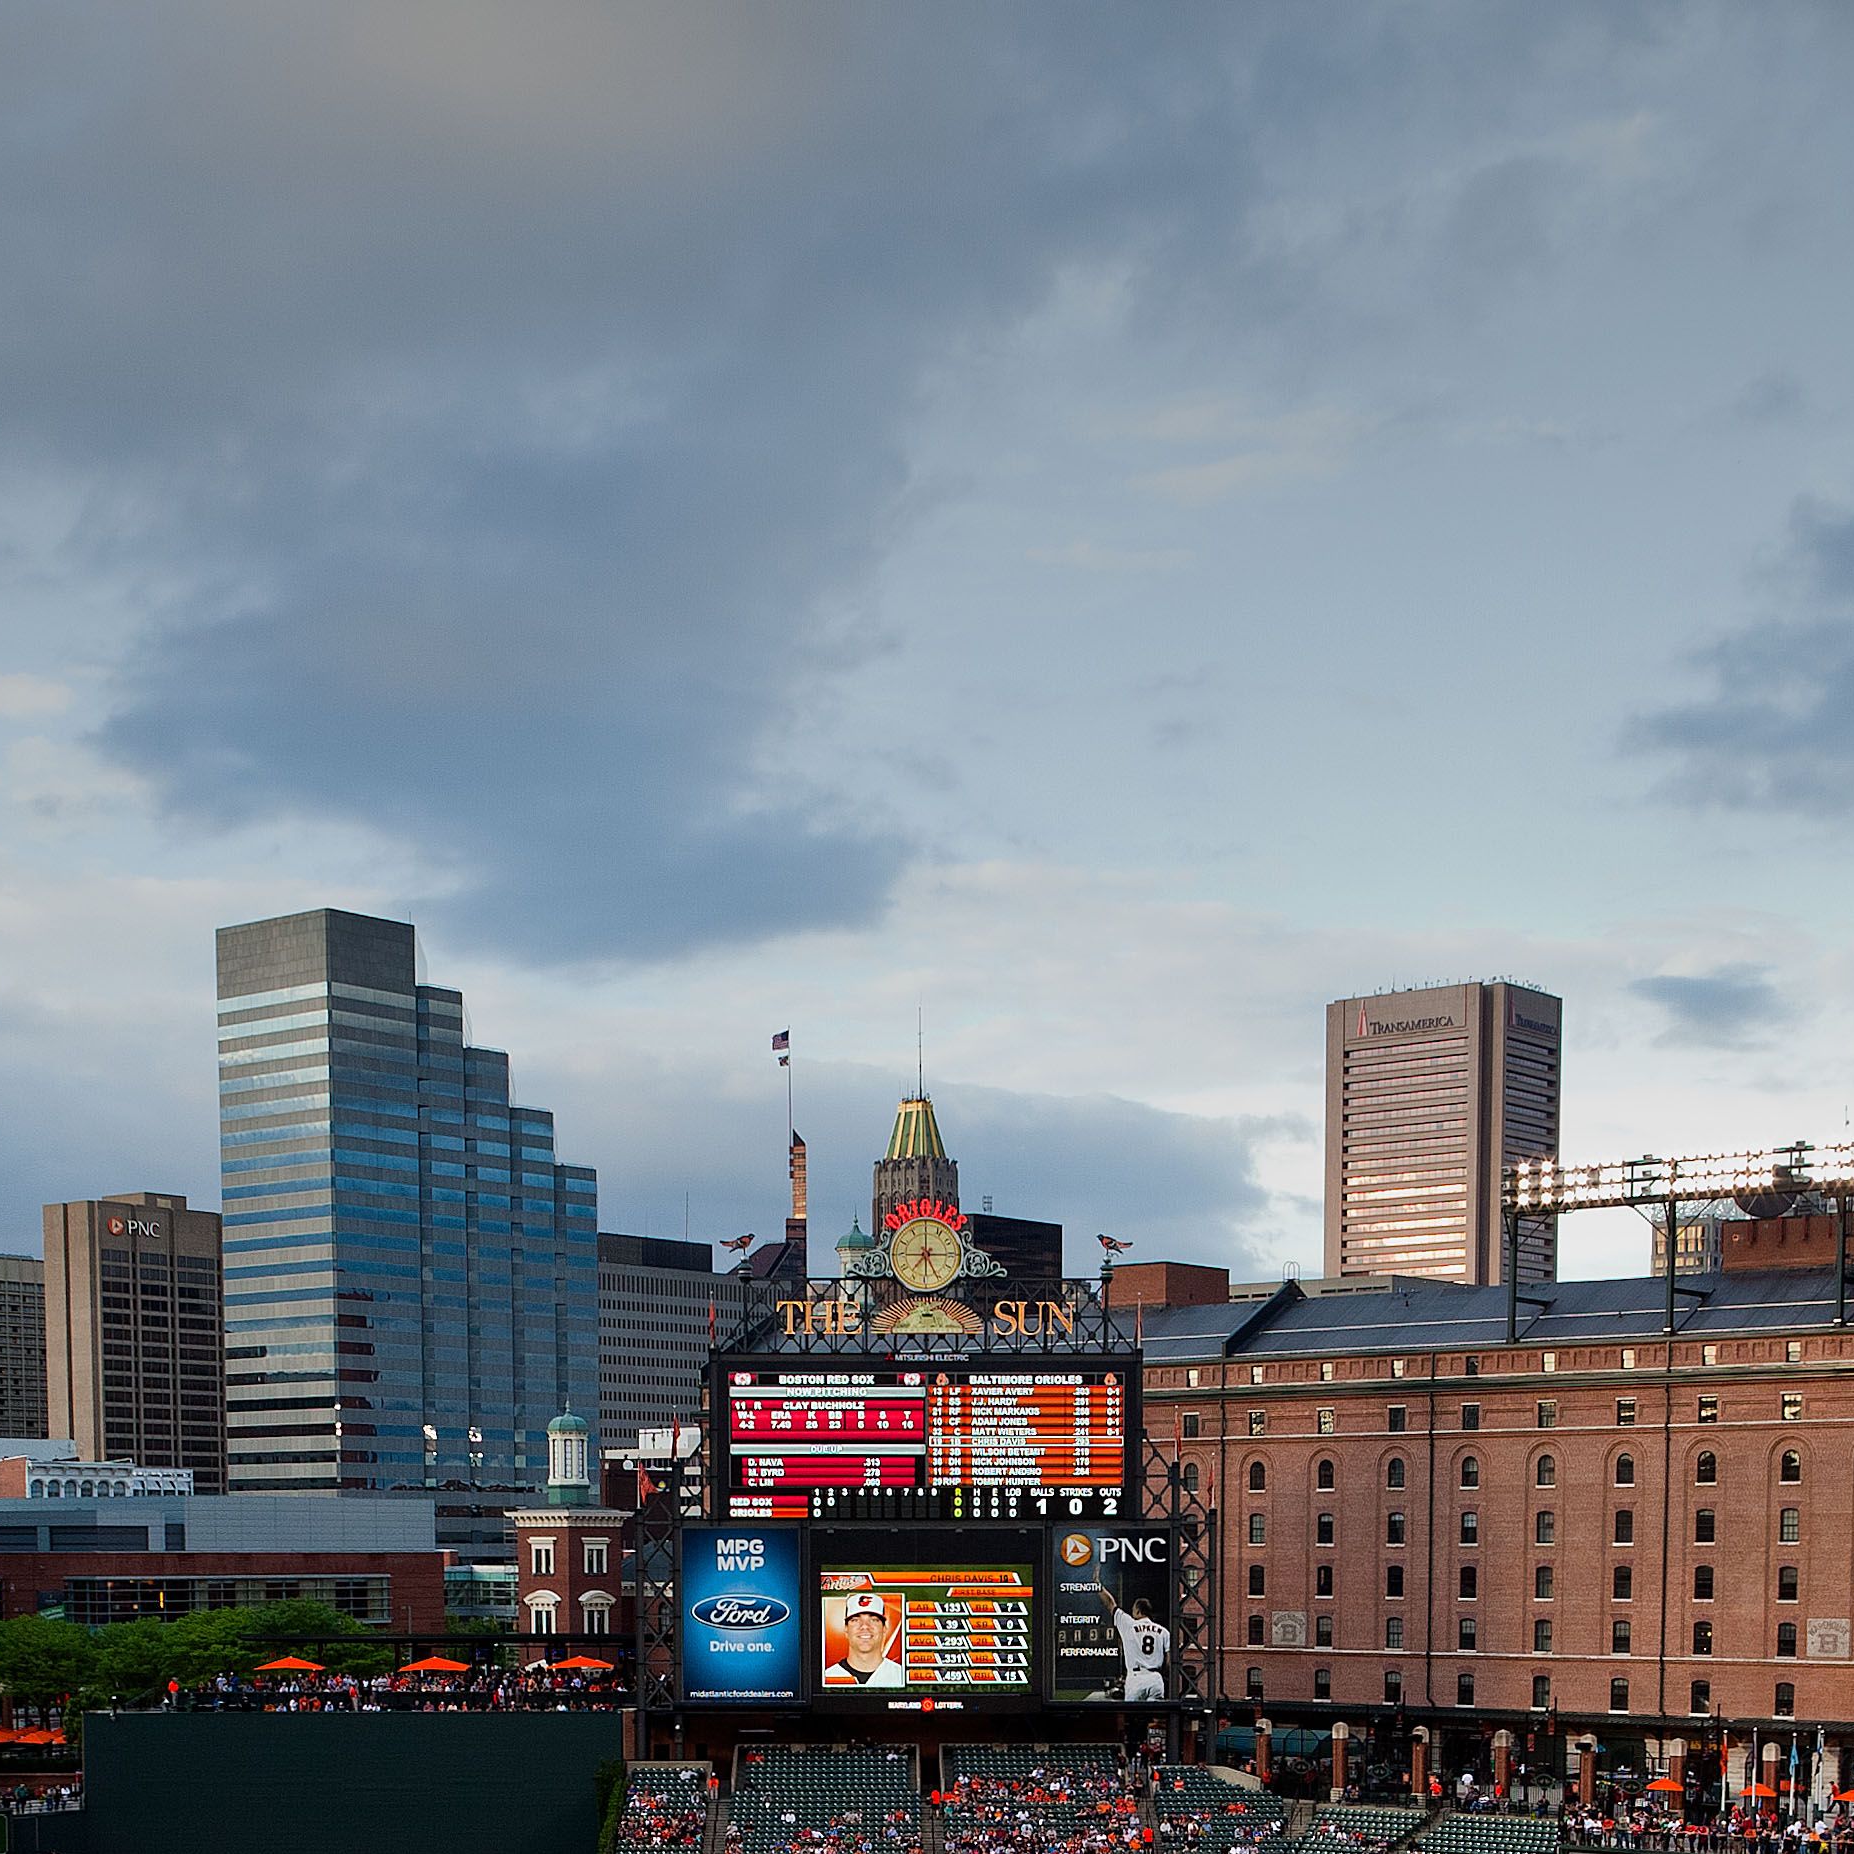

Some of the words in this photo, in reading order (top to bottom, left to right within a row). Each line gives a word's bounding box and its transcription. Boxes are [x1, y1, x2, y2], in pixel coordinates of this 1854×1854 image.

[1369, 1016, 1454, 1035] TRANSAMERICA
[883, 1198, 969, 1232] ORIOLES
[126, 1219, 161, 1238] PNC
[775, 1300, 863, 1335] THE
[993, 1300, 1076, 1337] SUN
[894, 1354, 934, 1362] MITSUBISHI
[934, 1354, 969, 1362] ELECTRIC
[779, 1375, 826, 1385] BOSTON
[826, 1375, 850, 1385] RED
[851, 1375, 875, 1385] SOX
[969, 1375, 1033, 1385] BALTIMORE
[1034, 1375, 1083, 1385] ORIOLES
[988, 1397, 1018, 1406] HARDY
[971, 1417, 998, 1426] ADAM
[999, 1417, 1028, 1426] JONES
[1005, 1477, 1041, 1486] HUNTER
[1030, 1488, 1054, 1497] BALLS
[1060, 1488, 1093, 1497] STRIKES
[1099, 1488, 1122, 1497] OUTS
[729, 1497, 750, 1506] RED
[1036, 1499, 1047, 1515] 1
[1069, 1498, 1083, 1515] 0
[1103, 1498, 1118, 1515] 2
[729, 1508, 773, 1517] ORIOLES
[717, 1539, 765, 1555] MPG
[1096, 1537, 1167, 1563] PNC
[717, 1556, 765, 1571] MVP
[930, 1574, 961, 1583] CHRIS
[965, 1574, 994, 1583] DAVIS
[1060, 1583, 1102, 1592] STRENGTH
[710, 1598, 771, 1624] Ford
[1060, 1615, 1101, 1624] INTEGRITY
[710, 1640, 745, 1652] Drive
[747, 1643, 775, 1652] one.
[1141, 1635, 1155, 1656] 8
[1060, 1648, 1119, 1657] PERFORMANCE
[690, 1690, 794, 1698] midatlanticforddealers.com
